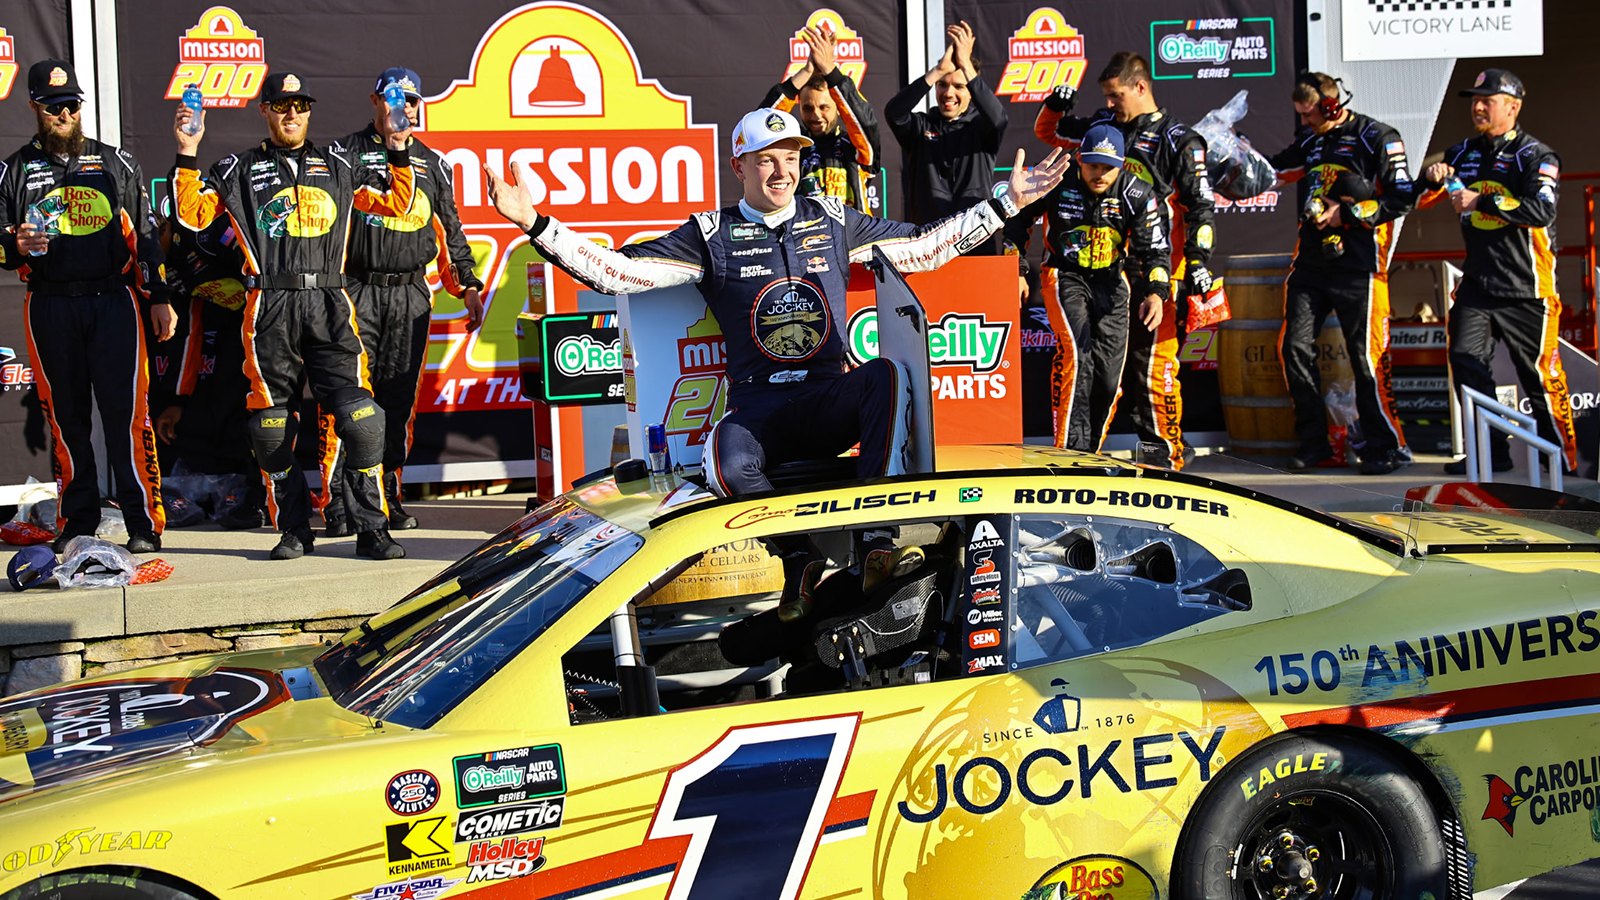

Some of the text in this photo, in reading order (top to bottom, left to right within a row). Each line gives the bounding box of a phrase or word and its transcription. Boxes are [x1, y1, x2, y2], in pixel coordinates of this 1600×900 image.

[1198, 19, 1238, 30] NASCAR
[1368, 15, 1512, 36] VICTORY LANE
[1162, 38, 1229, 61] O'Reilly
[1234, 36, 1265, 48] AUTO
[1231, 48, 1268, 60] PARTS
[170, 64, 266, 99] 200
[1000, 61, 1087, 95] 200
[1197, 68, 1230, 79] SERIES
[64, 187, 98, 201] Bass
[292, 187, 327, 201] Bass
[67, 201, 92, 214] Pro
[296, 201, 320, 214] Pro
[68, 213, 109, 229] Shops
[294, 214, 330, 231] Shop
[577, 246, 602, 266] GIVES
[732, 247, 773, 256] GOODYEAR
[891, 257, 914, 267] IVES
[767, 302, 814, 315] JOCKEY
[1391, 331, 1428, 344] nited
[561, 342, 621, 372] O'Rei
[1164, 362, 1173, 393] BOATS
[434, 378, 478, 405] AT
[142, 429, 162, 509] TRACKER
[794, 490, 937, 517] ZILISCH
[1014, 488, 1229, 517] ROTO-ROOTER
[968, 539, 1005, 551] AXALTA
[710, 554, 761, 567] CELLARS
[724, 570, 768, 581] RESTAURANT
[973, 632, 996, 646] SEM
[1361, 610, 1600, 688] ANNIVERS
[983, 713, 1136, 744] SINCE 1876
[496, 748, 529, 760] NASCAR
[529, 760, 554, 773] AUTO
[897, 725, 1227, 824] JOCKEY
[392, 773, 431, 790] NASCAR
[466, 769, 523, 789] O'Reilly
[526, 770, 558, 784] PARTS
[1240, 753, 1328, 802] EAGLE
[1515, 755, 1600, 800] CAROLI
[401, 787, 426, 798] 250
[498, 791, 527, 803] SERIES
[394, 794, 435, 812] SALUTES
[642, 711, 863, 900] 1
[1530, 785, 1600, 825] CARPO
[459, 802, 561, 837] COMETIC
[466, 831, 506, 840] GASKET
[2, 827, 173, 873] ODYEAR
[468, 837, 545, 866] Holley
[389, 857, 452, 876] KENNAMETAL
[467, 860, 534, 883] MSD
[374, 878, 444, 898] FIVE STAR
[1070, 865, 1124, 893] Bass
